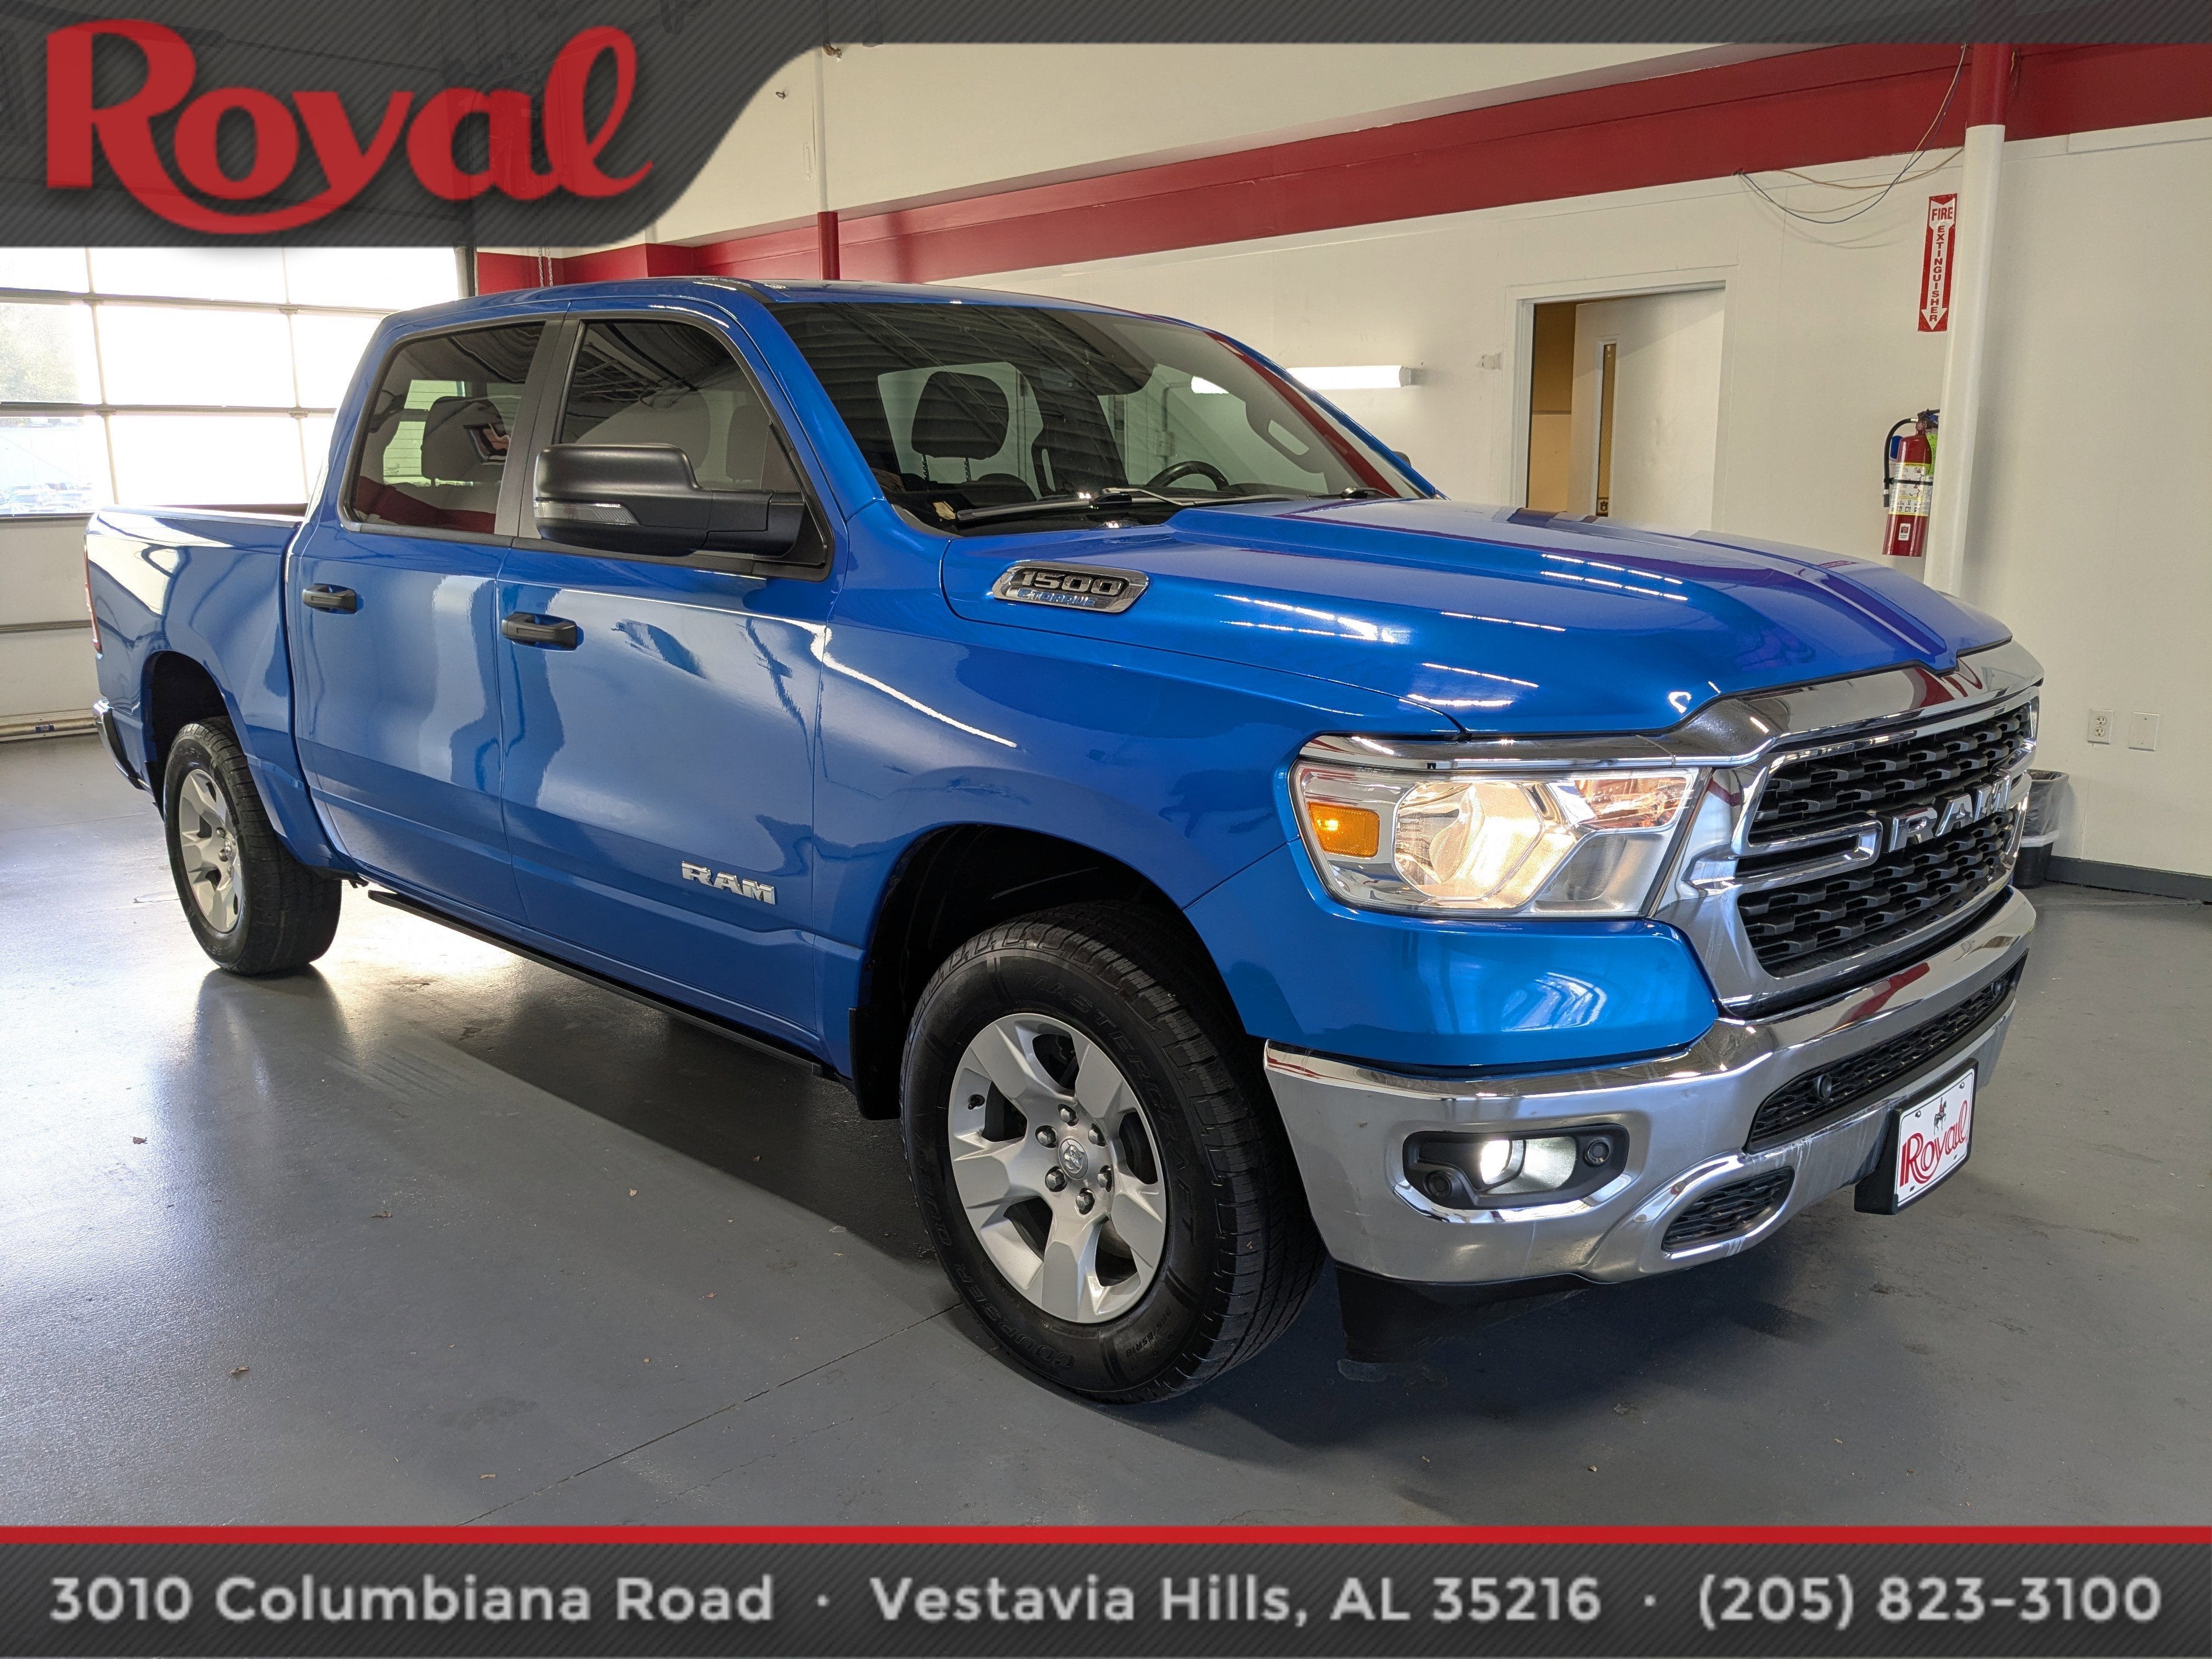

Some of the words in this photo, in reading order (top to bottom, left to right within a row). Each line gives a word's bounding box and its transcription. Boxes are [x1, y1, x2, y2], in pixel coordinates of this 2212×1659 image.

[1931, 207, 1954, 221] FIRE
[1929, 225, 1945, 322] EXTINGUISHER
[1022, 571, 1124, 596] 1500
[1889, 769, 2010, 853] RAM
[681, 860, 776, 905] RAM
[1022, 972, 1195, 1248] MASTERCRAFT
[1899, 1099, 1968, 1188] Royal
[953, 1262, 1075, 1368] COURSER
